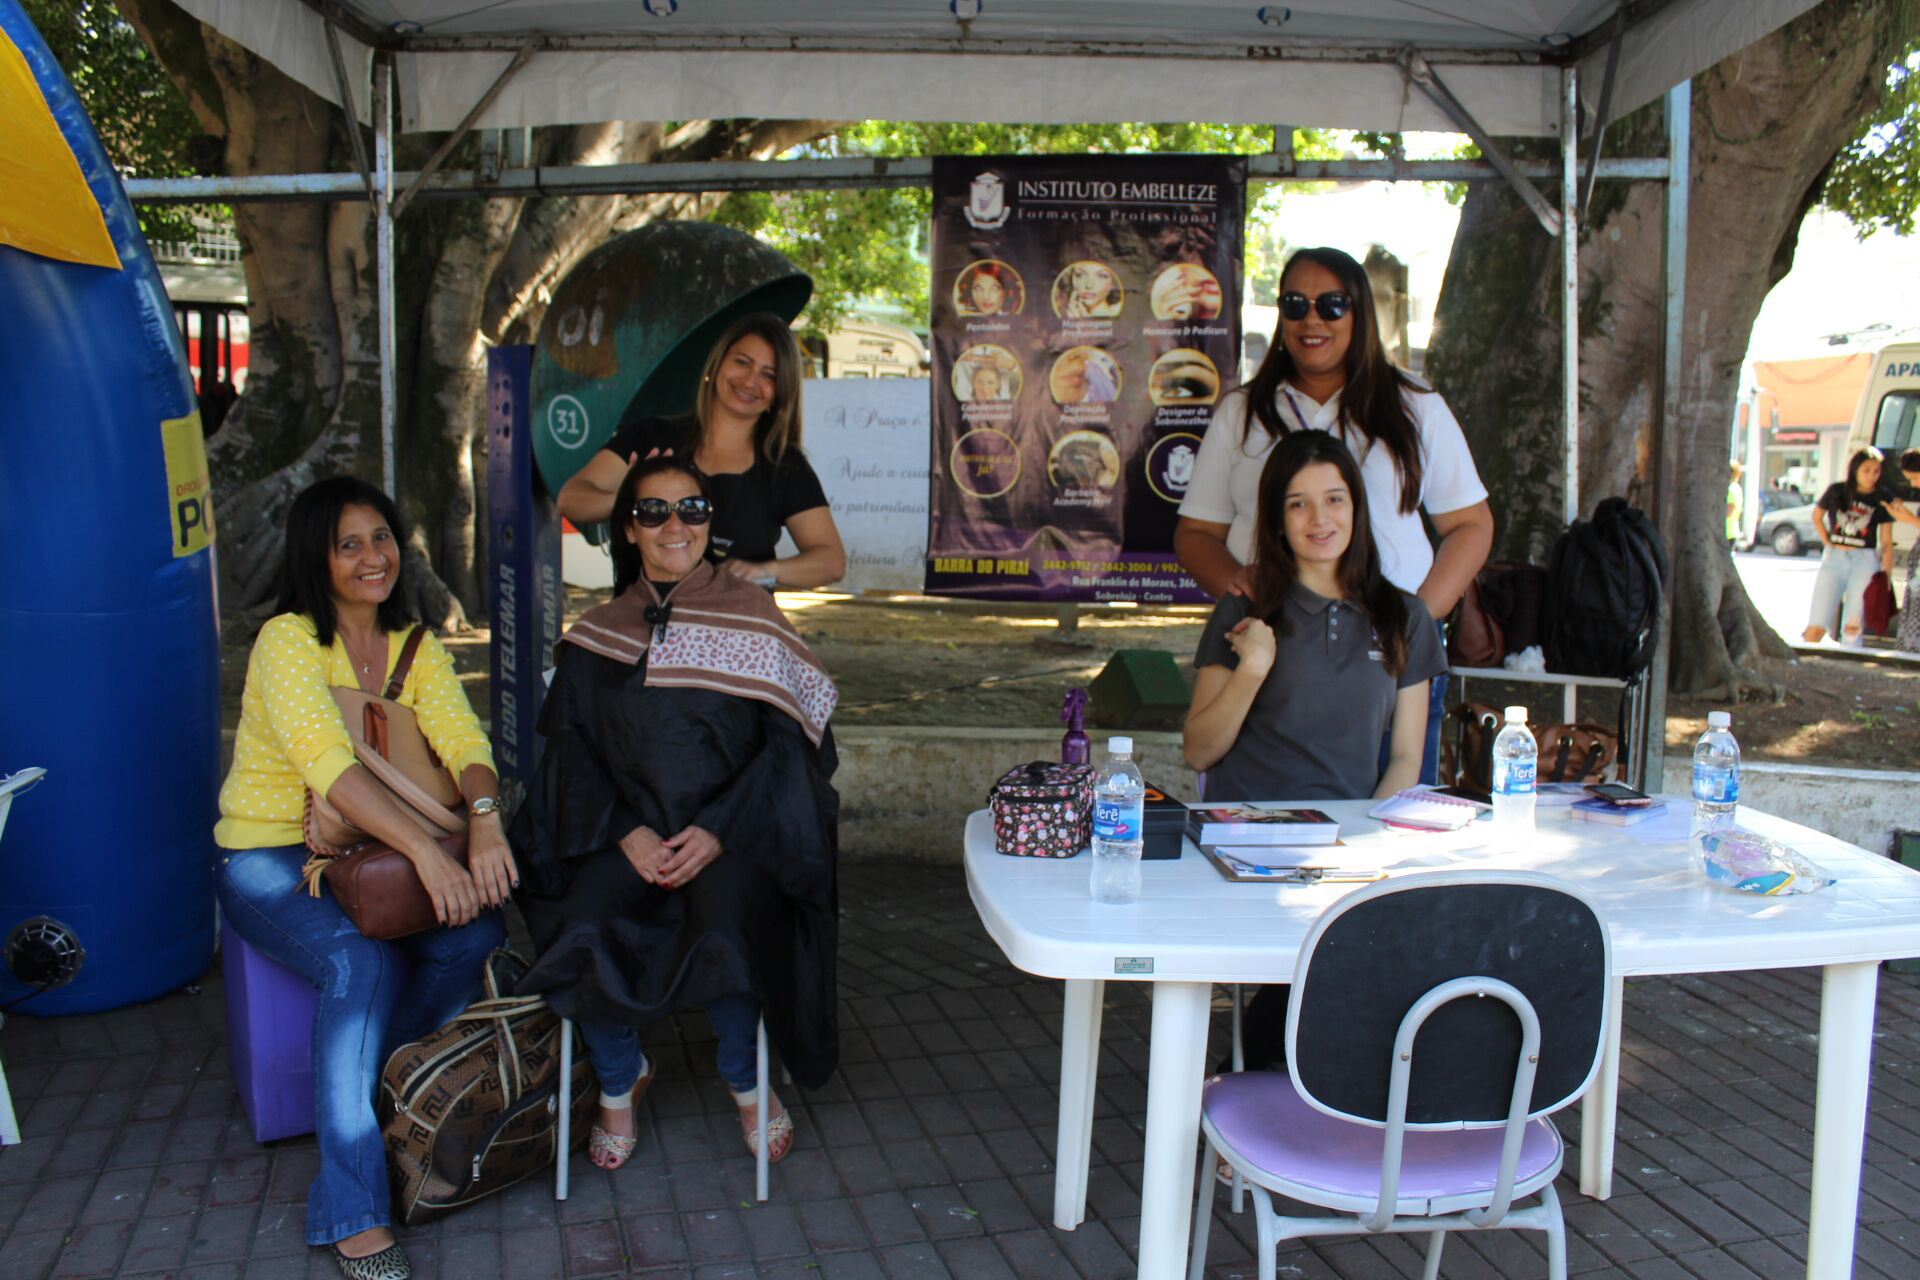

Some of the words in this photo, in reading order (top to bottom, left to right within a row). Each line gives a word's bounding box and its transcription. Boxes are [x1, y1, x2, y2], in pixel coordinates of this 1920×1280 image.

[1018, 180, 1117, 199] INSTITUTO
[1121, 182, 1217, 201] EMBELLEZE
[1018, 207, 1101, 223] Formação
[1110, 209, 1217, 224] Profissional
[1192, 326, 1228, 336] Pedicure
[1158, 407, 1195, 418] Designer
[1196, 407, 1208, 417] de
[556, 409, 580, 434] 31
[934, 558, 973, 574] BARRA
[977, 559, 994, 574] DO
[996, 558, 1030, 575] PIRAÍ
[1072, 575, 1089, 586] Rua
[1091, 576, 1127, 587] Franklin
[1129, 577, 1140, 587] de
[1141, 577, 1178, 588] Moraes,
[1144, 591, 1174, 601] Centro
[500, 563, 516, 684] TELEMAR
[542, 564, 557, 674] ELEMAR
